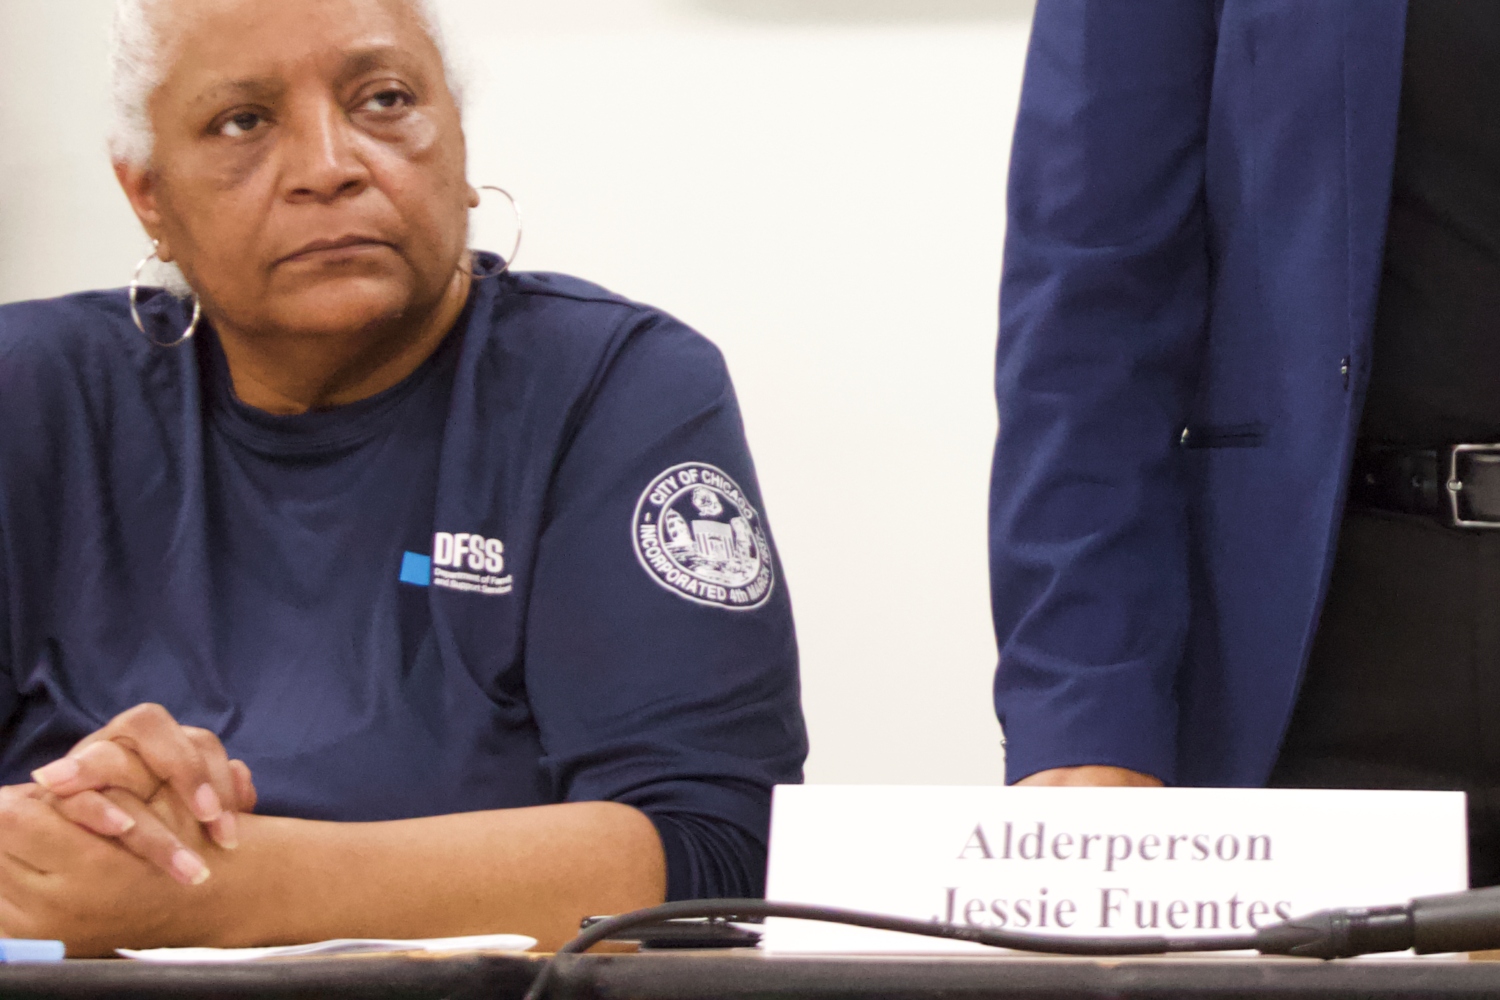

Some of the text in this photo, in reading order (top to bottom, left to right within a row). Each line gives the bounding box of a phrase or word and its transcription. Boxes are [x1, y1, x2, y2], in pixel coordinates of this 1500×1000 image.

[650, 469, 753, 519] CITY OF CHICAGO
[434, 532, 504, 573] DFSS
[640, 524, 728, 600] INCORPORATED
[957, 822, 1273, 871] Alderperson
[932, 887, 1292, 929] Jessie Fuentes
